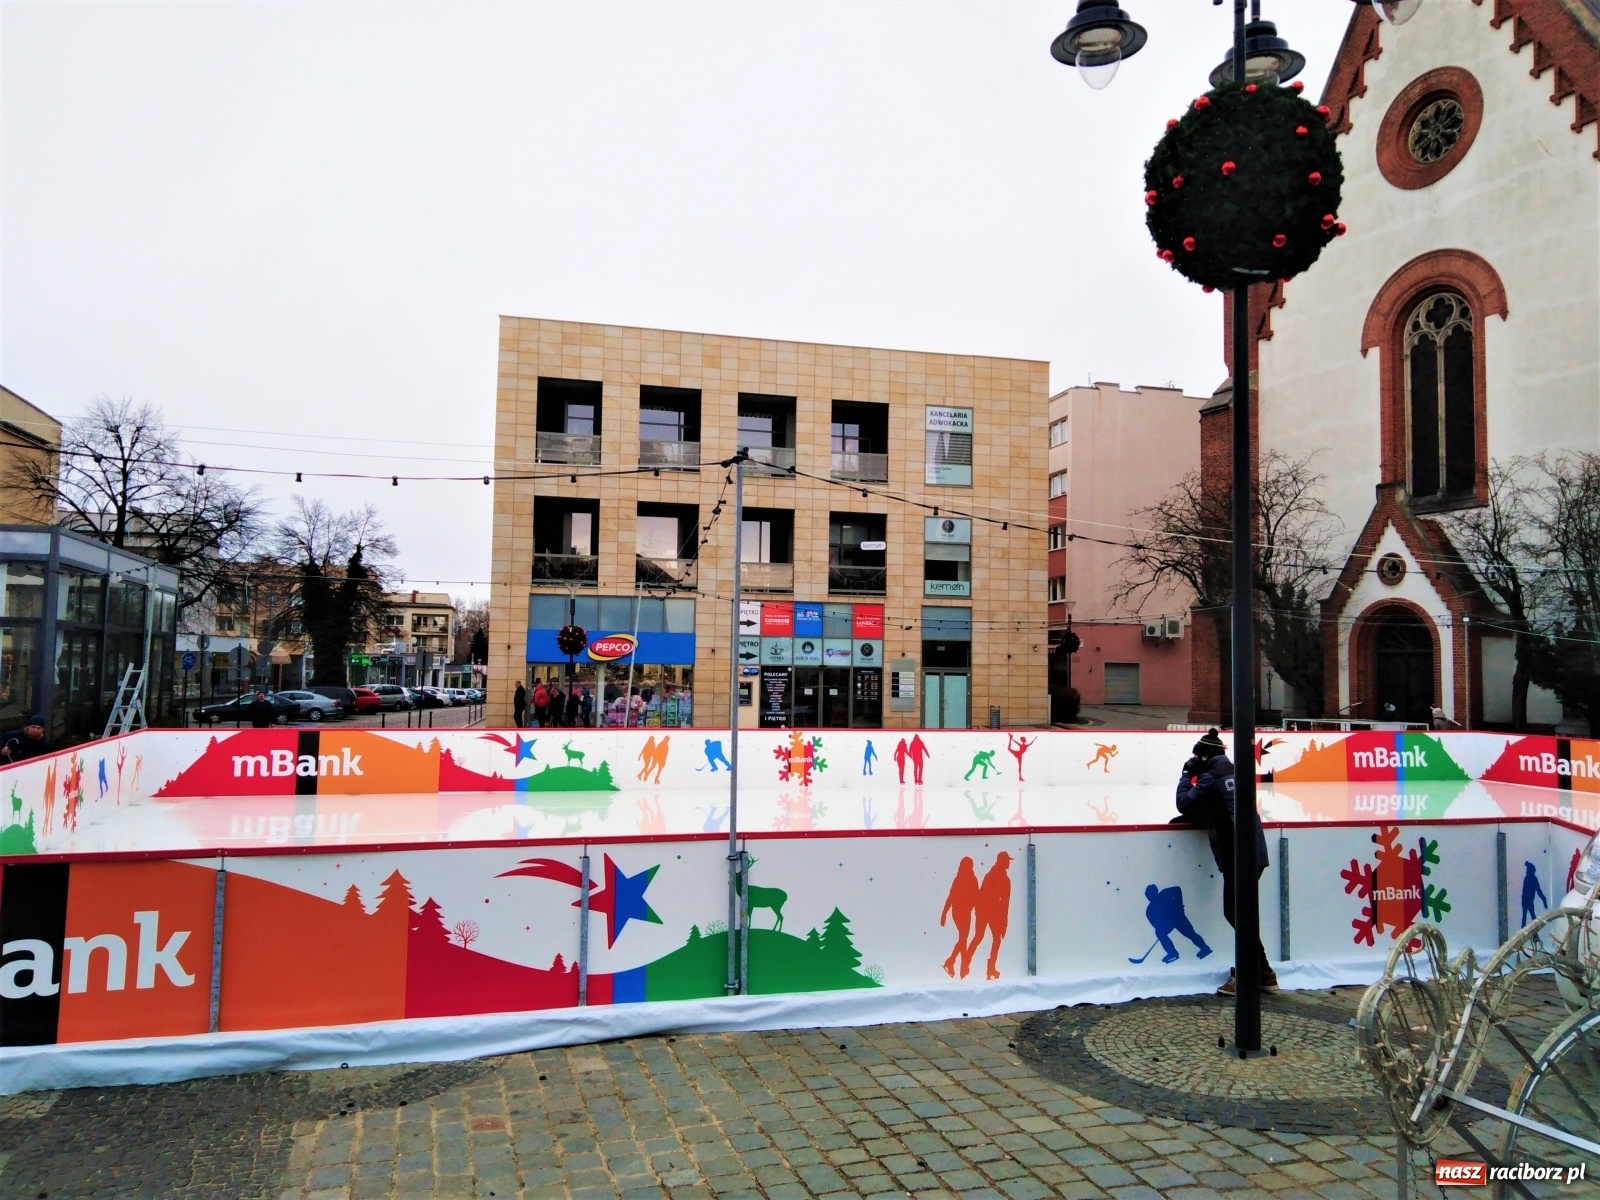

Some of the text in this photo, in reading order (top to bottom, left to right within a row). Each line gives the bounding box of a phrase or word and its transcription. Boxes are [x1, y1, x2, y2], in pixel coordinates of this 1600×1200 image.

[929, 419, 969, 428] ADWOKACKA
[930, 410, 968, 419] KANCELARIA
[595, 642, 631, 653] PEPCO
[232, 747, 364, 777] mBank
[1353, 745, 1428, 768] mBank
[1518, 752, 1600, 781] mBank
[1372, 885, 1421, 901] mBank
[0, 910, 195, 999] ank
